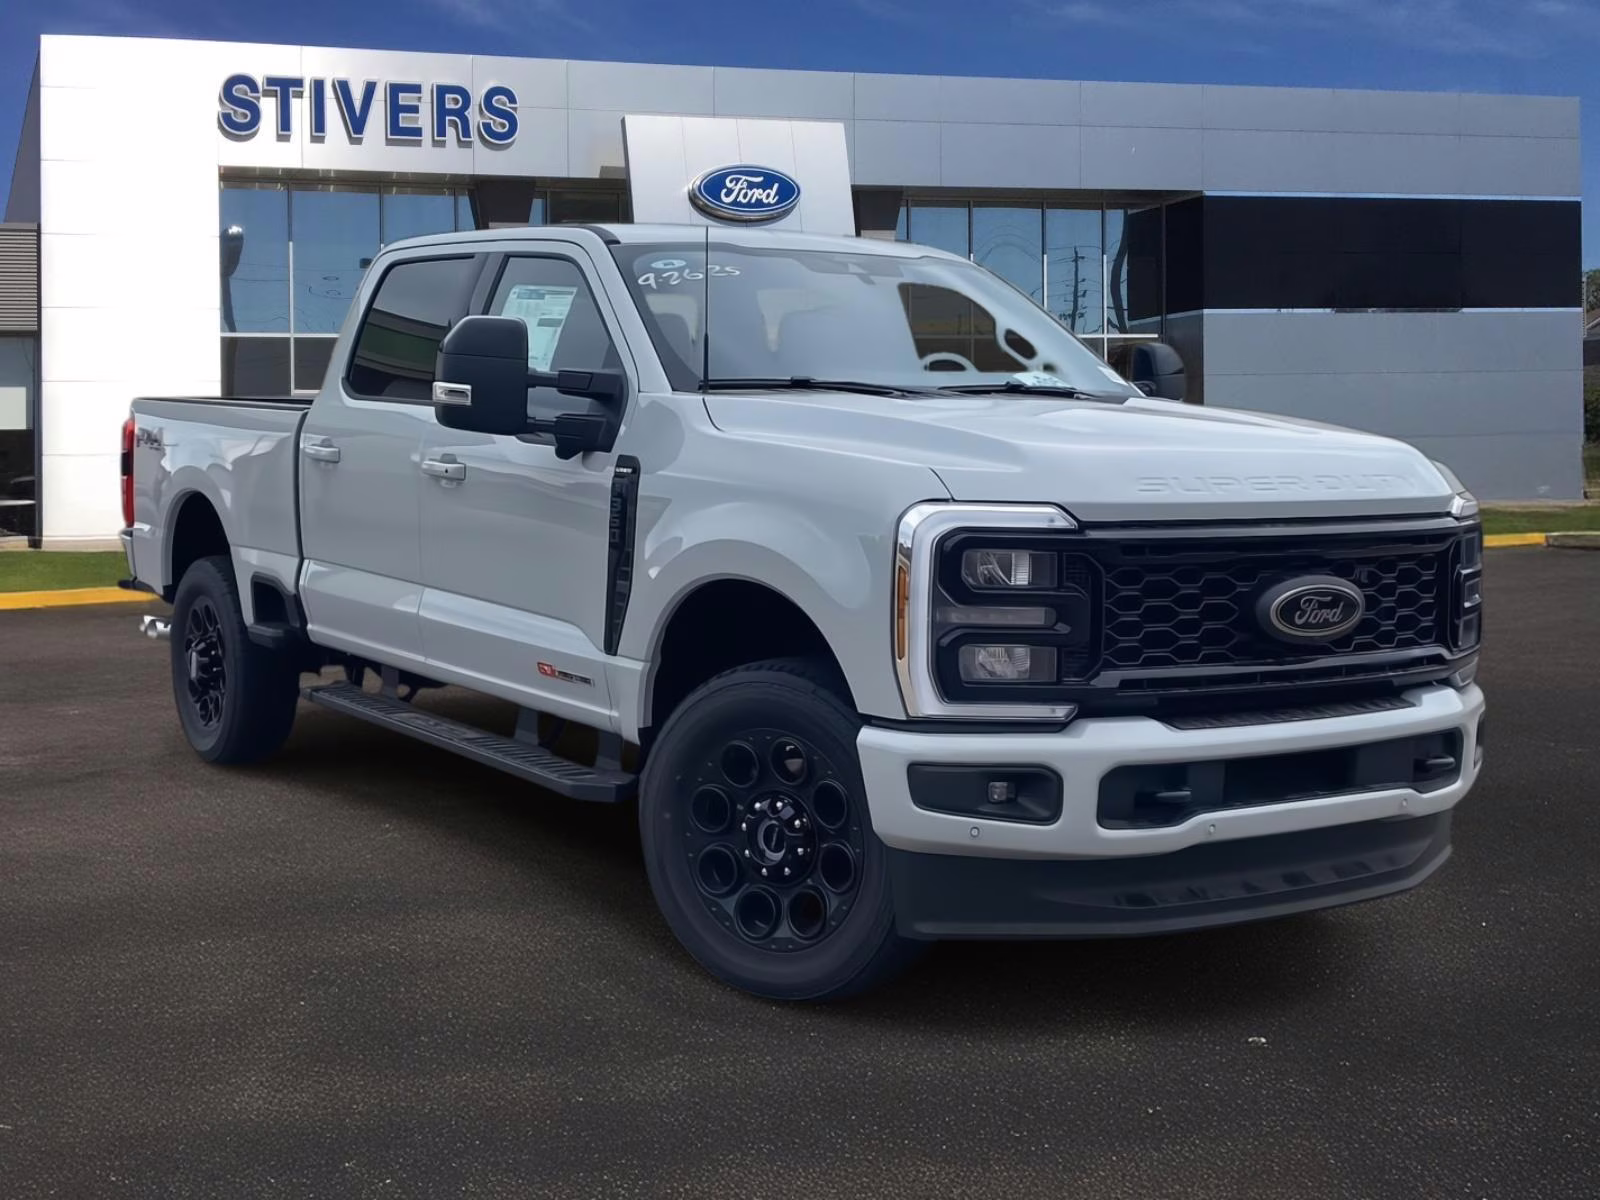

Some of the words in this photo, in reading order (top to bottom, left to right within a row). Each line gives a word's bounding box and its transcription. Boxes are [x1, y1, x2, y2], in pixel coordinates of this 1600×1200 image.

[217, 73, 519, 145] STIVERS
[720, 174, 779, 204] Ford
[1136, 475, 1309, 494] SUPER
[1294, 595, 1344, 625] Ford
